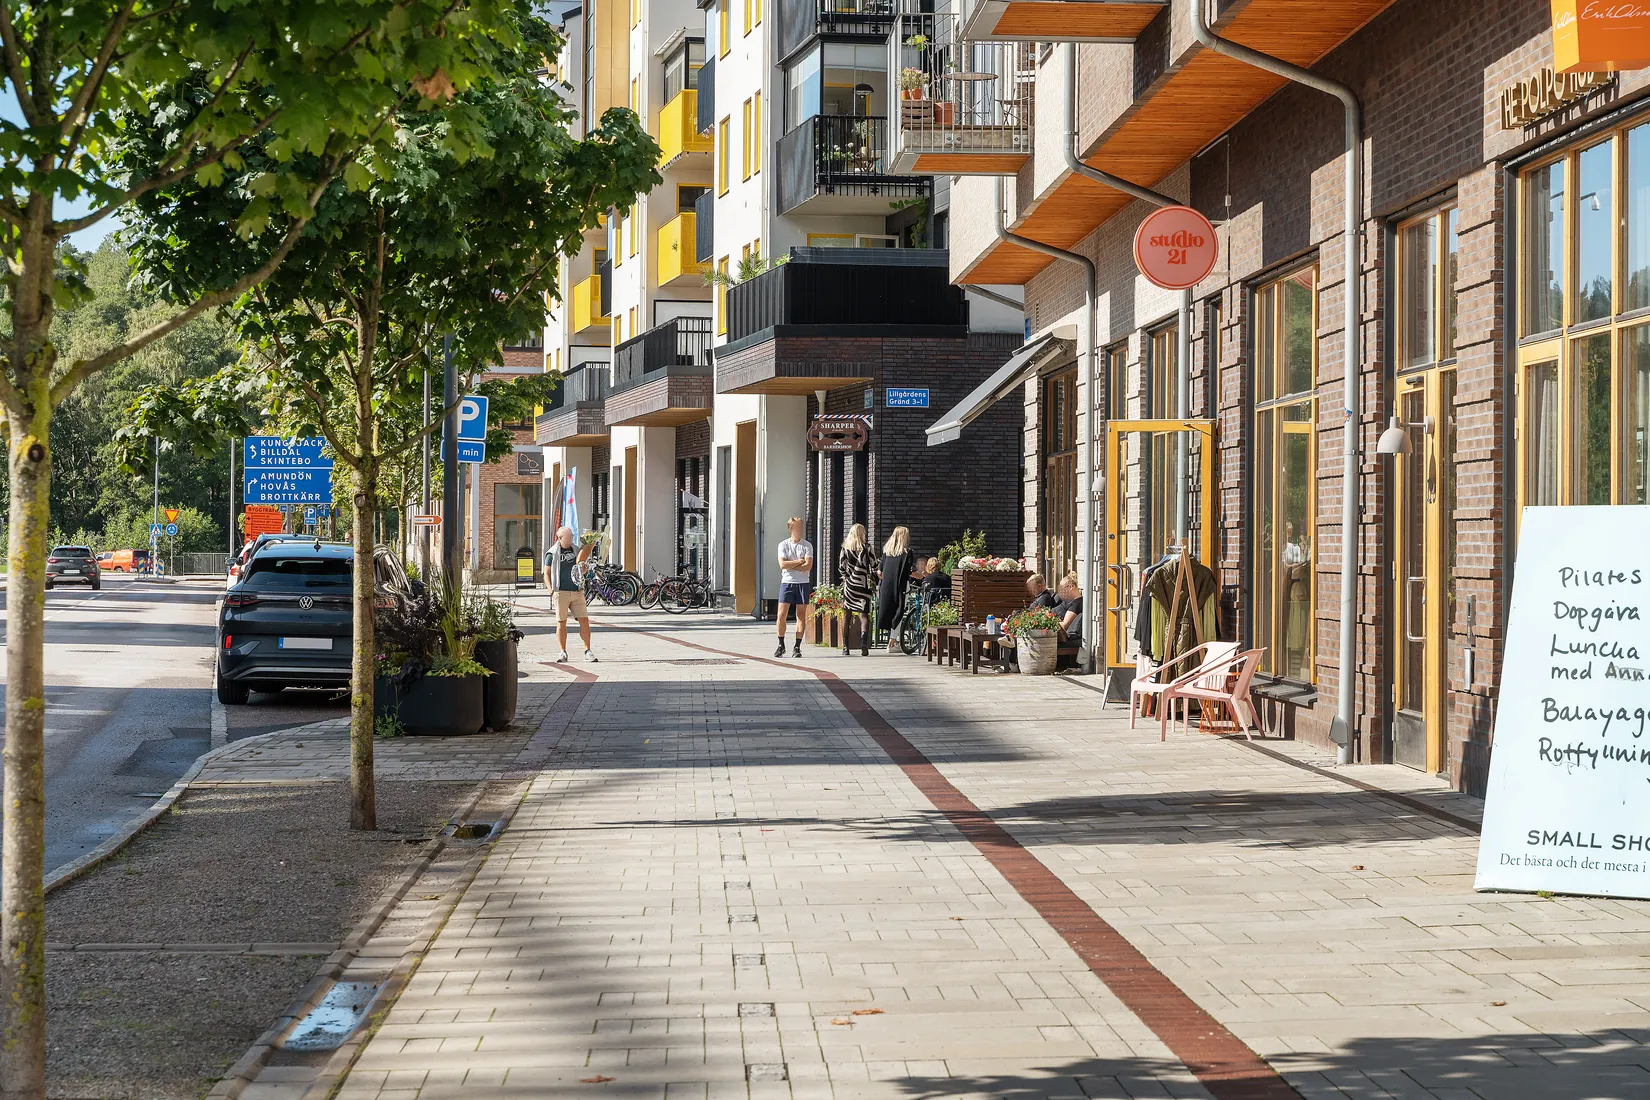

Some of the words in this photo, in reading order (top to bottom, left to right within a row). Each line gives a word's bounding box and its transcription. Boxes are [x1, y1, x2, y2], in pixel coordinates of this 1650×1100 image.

[1521, 64, 1566, 119] POLPO
[1149, 229, 1205, 248] studio
[1167, 249, 1187, 265] 21
[889, 390, 927, 398] Lillgårdens
[457, 400, 480, 434] P
[260, 439, 331, 447] KUNGACKA
[260, 448, 301, 456] BILLDAL
[462, 448, 479, 457] min
[260, 457, 311, 465] SKINTEBO
[260, 471, 312, 480] AMUNDÖN
[260, 481, 296, 490] HOVÅS
[260, 492, 321, 501] BROTTKÄRR
[307, 508, 315, 518] P
[1558, 566, 1642, 588] Pilates
[1551, 661, 1592, 680] med
[1605, 661, 1650, 681] Ann
[1538, 737, 1650, 770] Rotfyllnin
[1526, 829, 1602, 849] SMALL
[1500, 853, 1521, 866] Det
[1524, 853, 1553, 867] bästa
[1556, 856, 1577, 869] och
[1581, 856, 1600, 870] det
[1604, 861, 1639, 873] mesta
[1642, 861, 1646, 872] i
